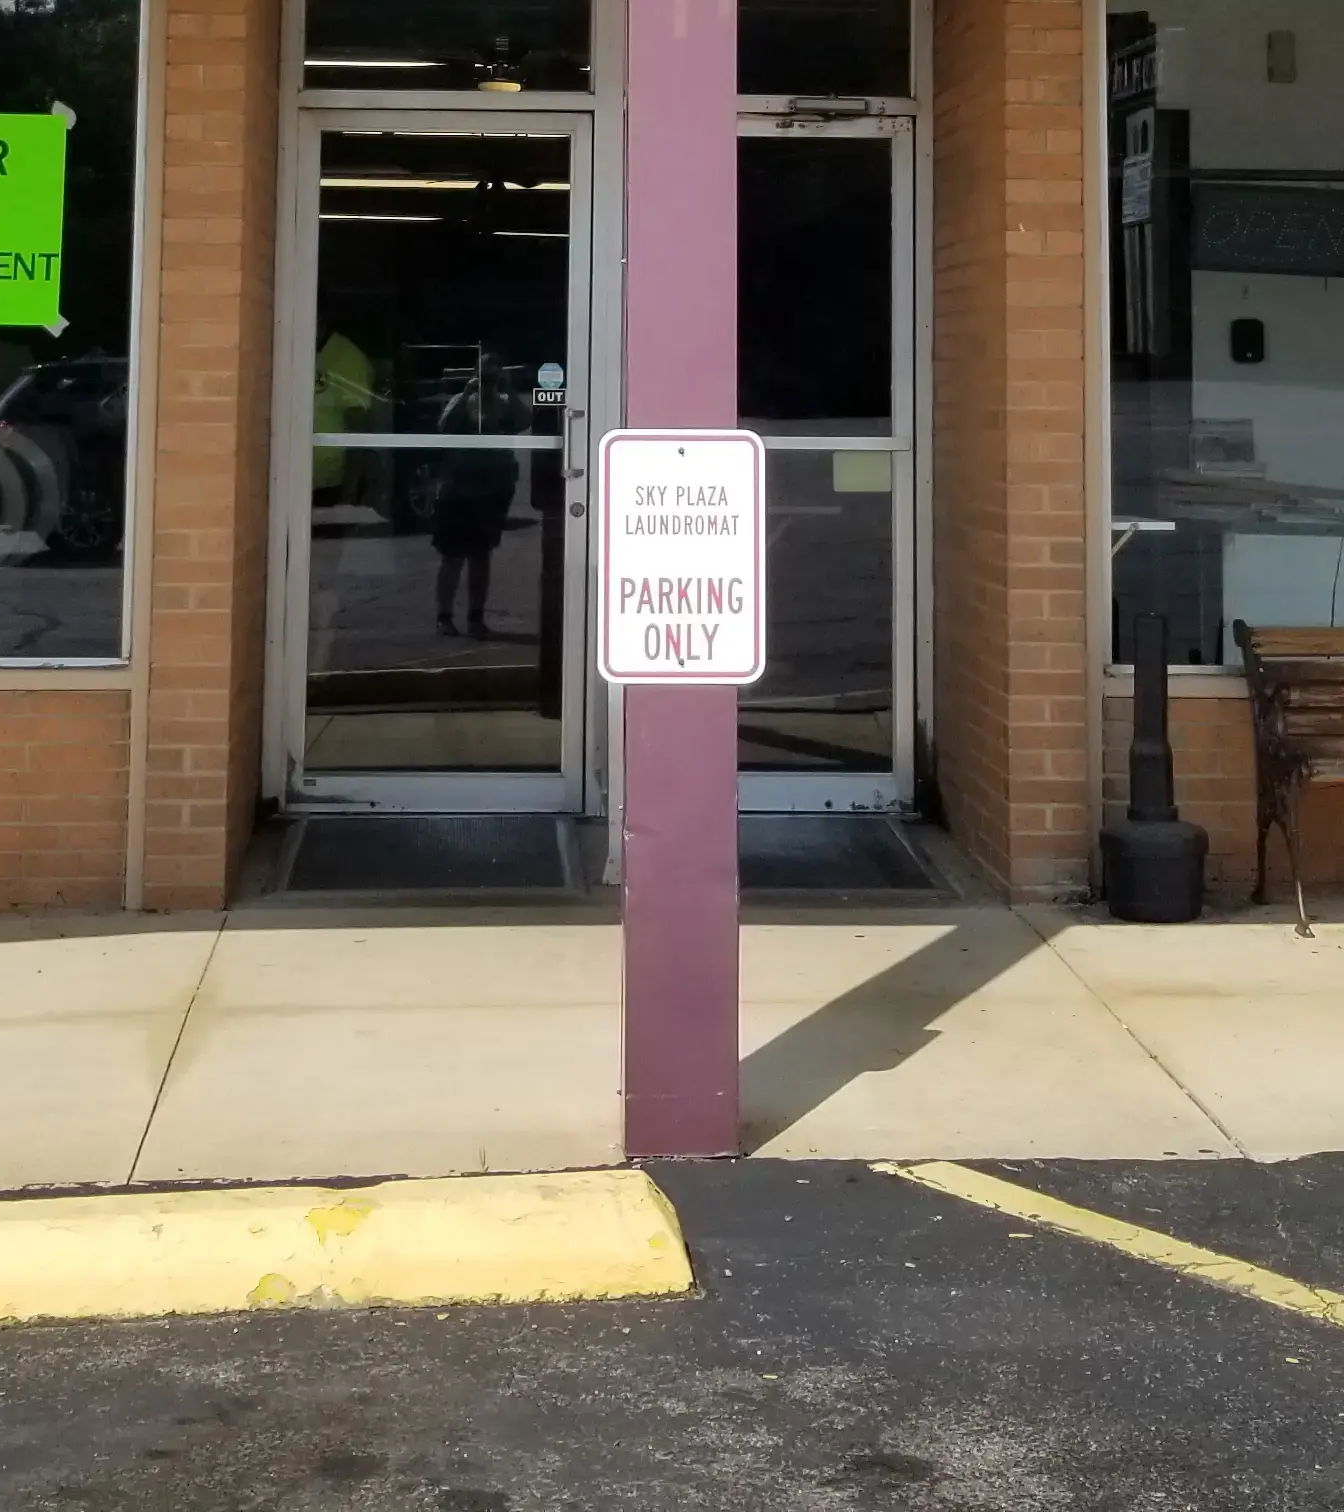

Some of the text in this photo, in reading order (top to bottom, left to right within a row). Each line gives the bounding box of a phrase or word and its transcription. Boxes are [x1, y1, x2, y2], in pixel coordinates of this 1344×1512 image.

[537, 391, 563, 402] OUT
[635, 486, 728, 506] SKY PLAZA
[626, 515, 739, 535] LAUNDROMAT
[620, 577, 744, 615] PARKING
[644, 622, 720, 660] ONLY
